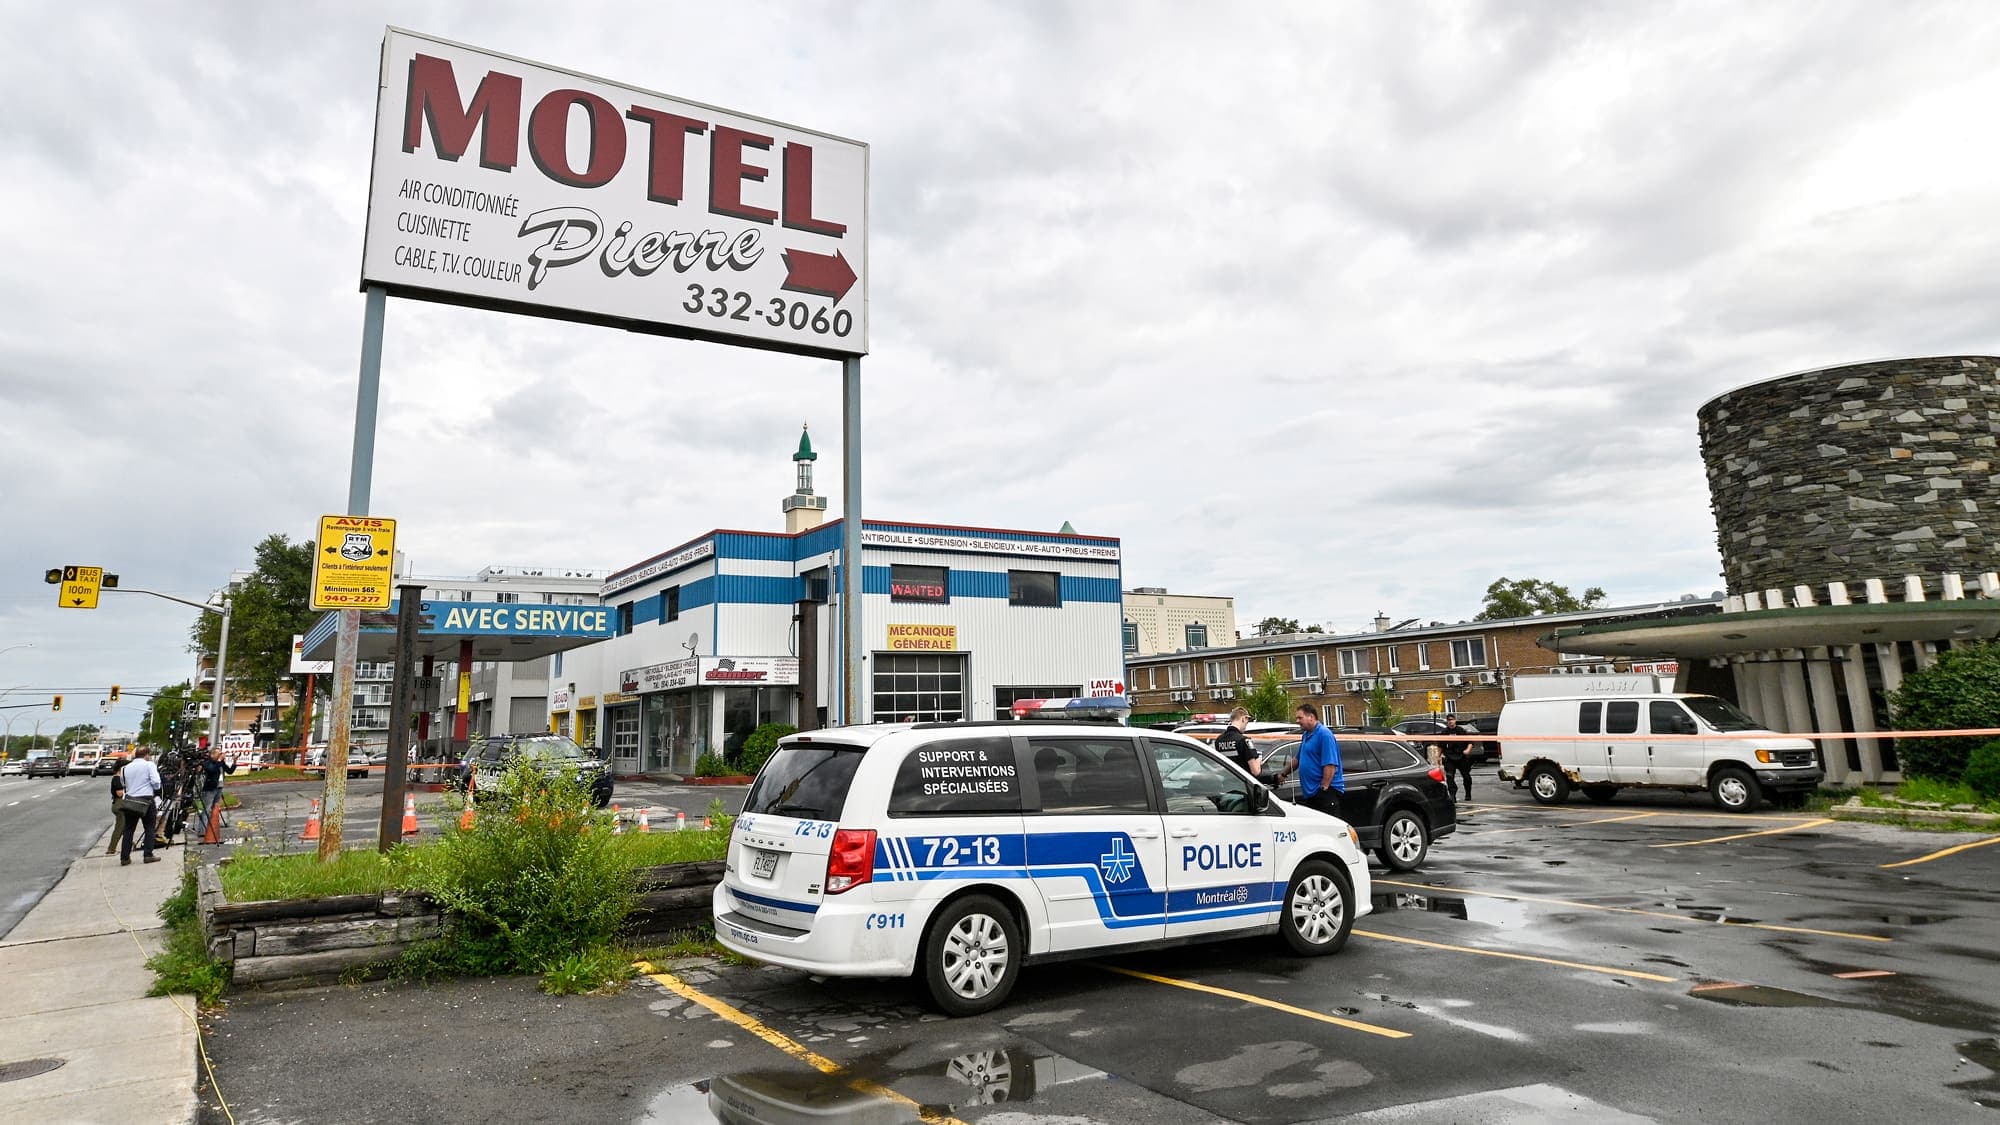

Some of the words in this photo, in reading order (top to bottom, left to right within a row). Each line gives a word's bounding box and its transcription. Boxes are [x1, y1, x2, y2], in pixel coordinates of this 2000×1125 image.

[402, 53, 847, 239] MOTEL
[399, 178, 422, 200] AIR
[423, 182, 519, 218] CONDITIONNÉE
[397, 212, 471, 242] CUISINETTE
[517, 206, 764, 291] Pierre
[394, 245, 438, 274] CABLE,
[442, 252, 461, 275] T.V.
[463, 256, 522, 283] COULEUR
[683, 283, 853, 338] 332-3060
[336, 518, 383, 527] AVIS
[861, 533, 913, 544] ANTIROUILLE
[918, 536, 968, 548] SUSPENSION
[973, 540, 1016, 551] SILENCIEUX
[1020, 544, 1061, 554] LAVE-AUTO
[1065, 547, 1089, 556] PNEUS
[1092, 549, 1117, 557] FREINS
[80, 569, 98, 577] BUS
[68, 585, 92, 594] 100m
[324, 585, 360, 593] Minimum
[891, 583, 943, 597] WANTED
[324, 595, 380, 603] 940-2277
[444, 607, 509, 630] AVEC
[515, 609, 606, 632] SERVICE
[893, 637, 952, 650] GÉNÉRALE
[1090, 679, 1114, 689] LAVE
[1091, 690, 1114, 698] AUTO
[224, 741, 252, 749] LAVE
[1218, 741, 1237, 751] POLICE
[918, 750, 976, 763] SUPPORT
[978, 751, 988, 762] &
[921, 765, 1016, 779] INTERVENTIONS
[923, 779, 1009, 795] SPÉCIALISÉES
[795, 821, 833, 839] 72-13
[1274, 831, 1297, 842] 72-13
[923, 836, 1000, 866] 72-13
[1183, 843, 1262, 872] POLICE
[1196, 889, 1236, 905] Montréal
[877, 913, 905, 929] 911
